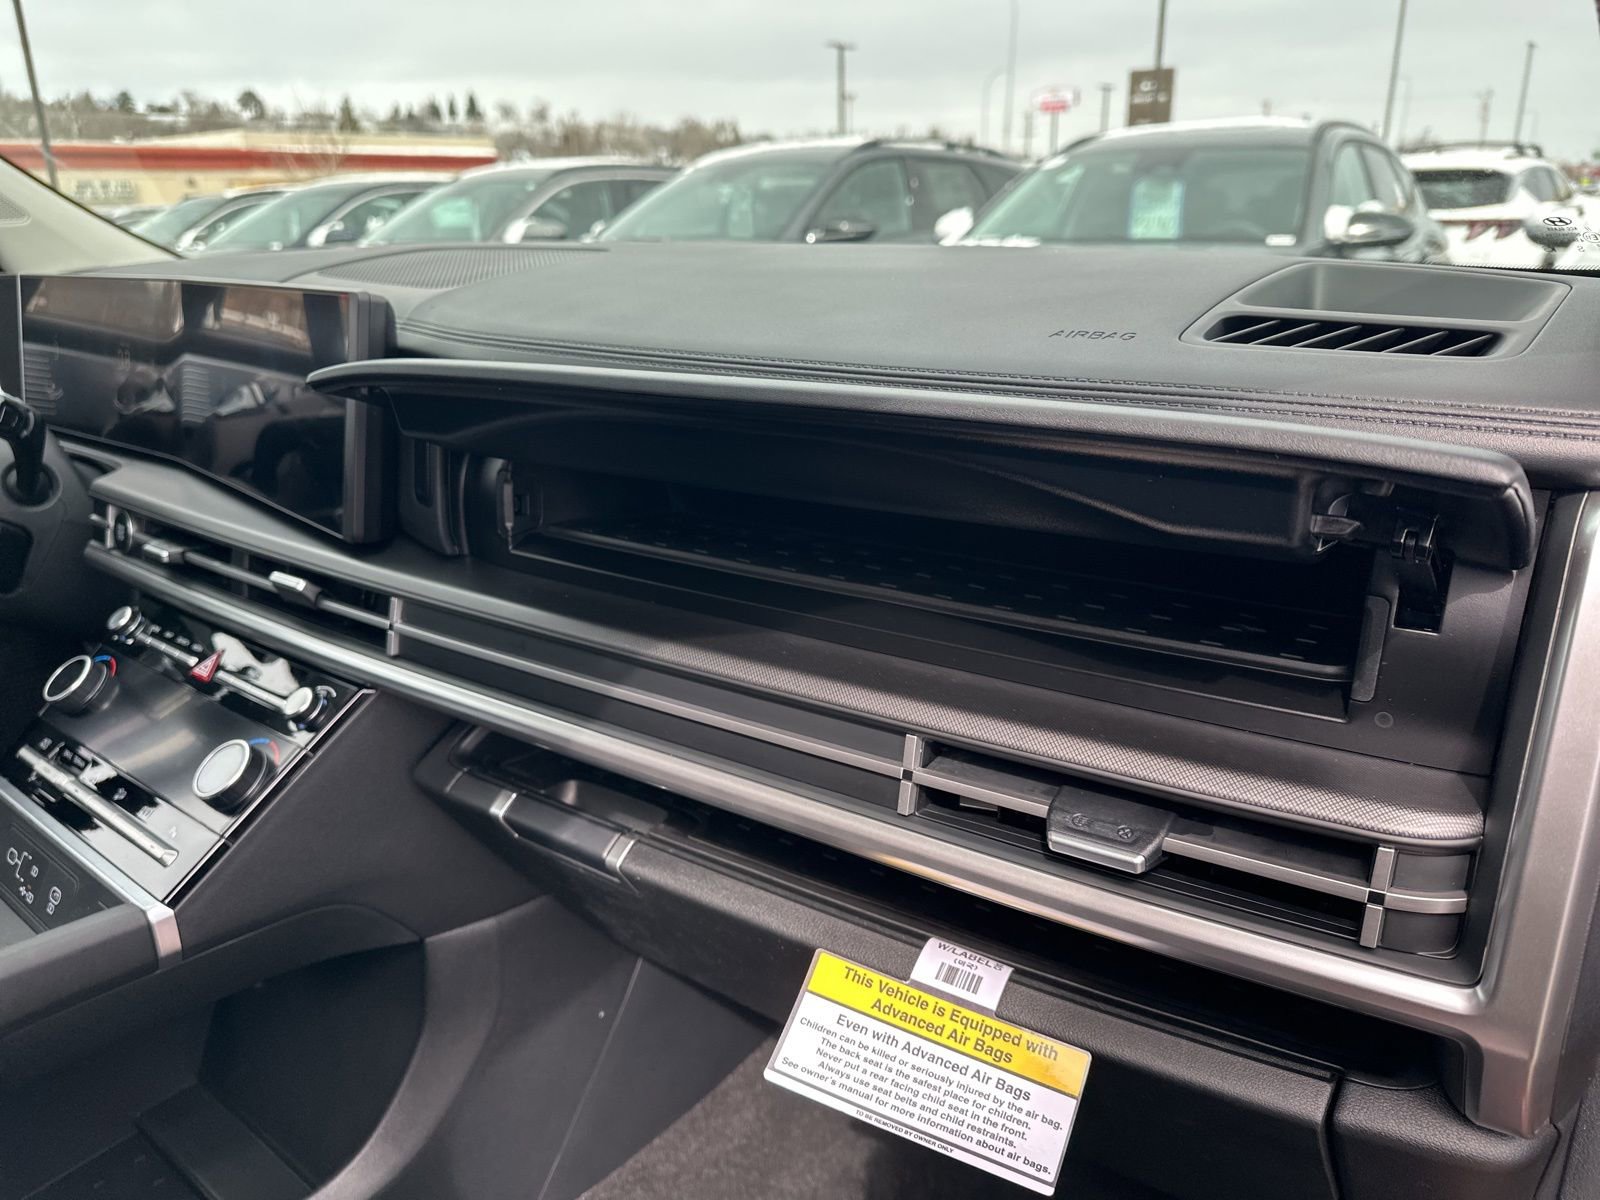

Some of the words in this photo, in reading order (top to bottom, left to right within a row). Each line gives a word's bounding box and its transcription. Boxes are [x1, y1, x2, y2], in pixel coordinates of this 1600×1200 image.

[1048, 330, 1136, 341] AIRBAG
[836, 1013, 868, 1035] Even
[871, 1029, 899, 1048] with
[900, 1040, 969, 1076] Advanced
[970, 1068, 992, 1085] Air
[994, 1076, 1031, 1101] Bags
[844, 965, 873, 988] This
[878, 978, 929, 1010] Vehicle
[931, 1000, 946, 1017] is
[948, 1007, 1022, 1047] Equipped
[1024, 1038, 1059, 1062] with
[870, 997, 946, 1037] Advanced
[945, 1027, 971, 1046] Air
[972, 1036, 1013, 1063] Bags
[781, 1056, 799, 1069] See
[800, 1066, 836, 1085] owner's
[838, 1082, 873, 1101] manual
[874, 1095, 889, 1107] for
[889, 1103, 915, 1119] more
[916, 1112, 974, 1143] information
[974, 1138, 1005, 1156] about
[1006, 1151, 1022, 1162] air
[1021, 1155, 1051, 1175] bags.
[799, 1016, 837, 1038] Children
[838, 1034, 856, 1046] can
[856, 1040, 869, 1051] be
[870, 1045, 897, 1062] killed
[897, 1058, 909, 1067] or
[910, 1063, 954, 1087] seriously
[955, 1080, 991, 1101] injured
[991, 1094, 1005, 1108] by
[1006, 1100, 1023, 1114] the
[1024, 1109, 1040, 1120] air
[1040, 1113, 1063, 1131] bag.
[815, 1047, 842, 1063] Never
[842, 1060, 860, 1072] put
[868, 1070, 888, 1083] rear
[889, 1078, 920, 1098] facing
[921, 1092, 946, 1107] child
[946, 1103, 969, 1117] seat
[969, 1110, 980, 1121] in
[981, 1115, 999, 1129] the
[999, 1122, 1027, 1141] front.
[817, 1060, 850, 1080] Always
[852, 1076, 870, 1088] use
[871, 1084, 892, 1098] seat
[893, 1091, 917, 1108] belts
[918, 1104, 939, 1116] and
[939, 1112, 965, 1127] child
[965, 1122, 1016, 1149] restraints.
[820, 1036, 837, 1050] The
[838, 1044, 860, 1060] back
[862, 1056, 883, 1069] seat
[884, 1062, 893, 1073] is
[894, 1068, 910, 1080] the
[911, 1076, 942, 1093] safest
[942, 1088, 970, 1104] place
[971, 1098, 986, 1111] for
[987, 1107, 1031, 1130] children.
[873, 1117, 904, 1132] REMOVED
[912, 1133, 936, 1147] OWNER
[936, 1142, 954, 1153] ONLY
